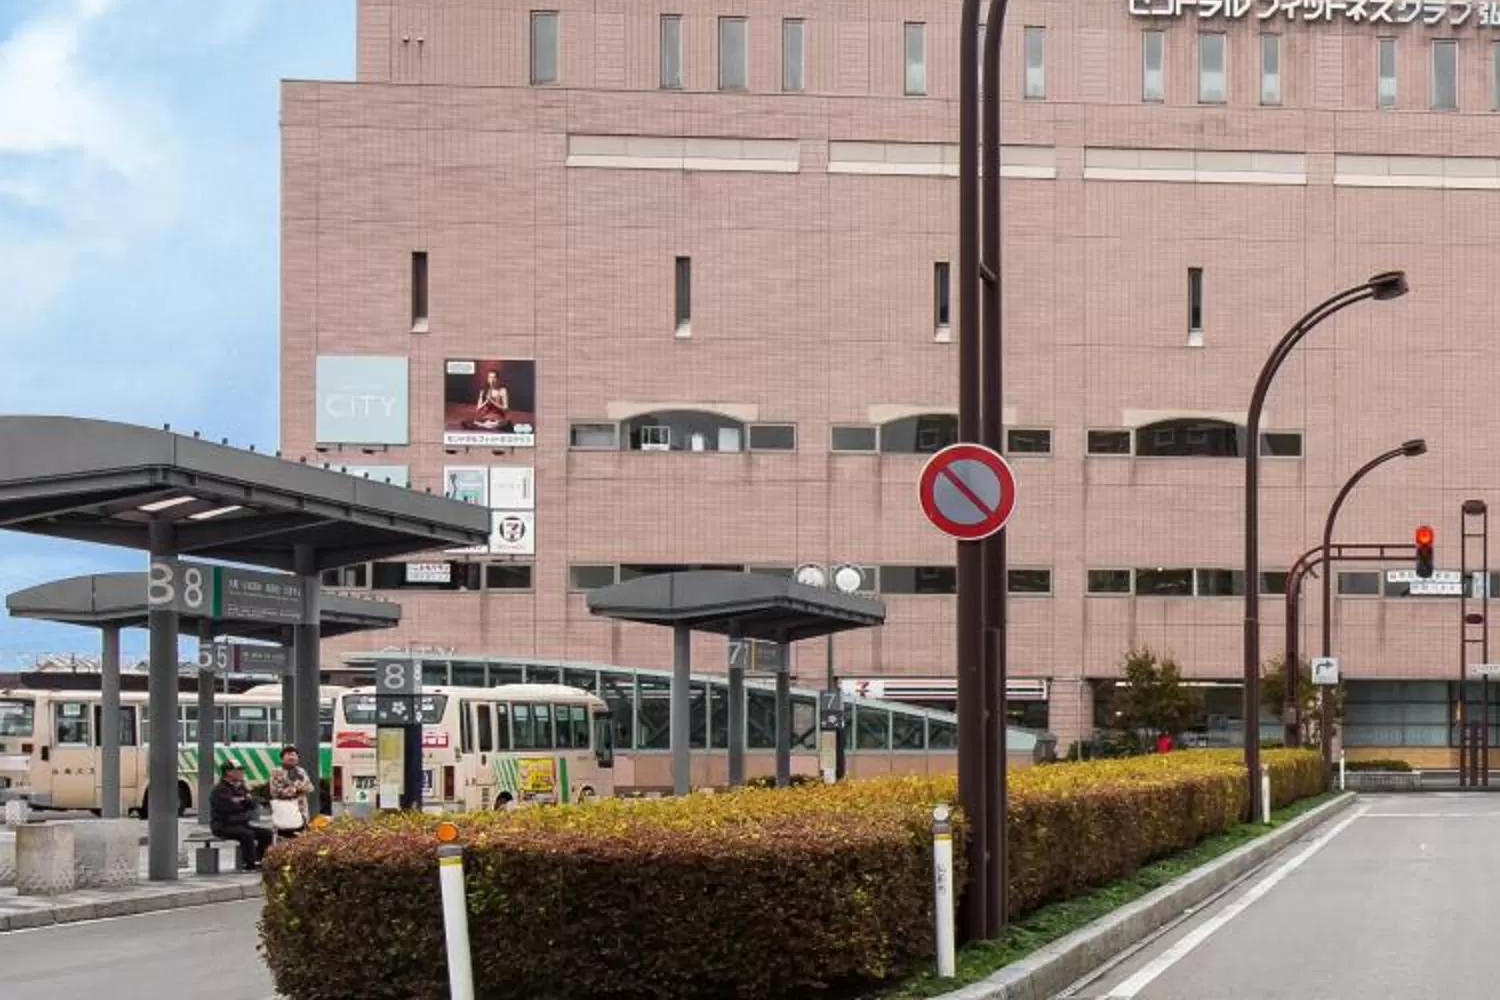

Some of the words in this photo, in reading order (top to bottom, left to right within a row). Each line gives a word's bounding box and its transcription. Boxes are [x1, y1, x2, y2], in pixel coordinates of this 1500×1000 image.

[325, 393, 397, 418] CITY
[383, 663, 406, 690] 8
[823, 692, 837, 710] 7
